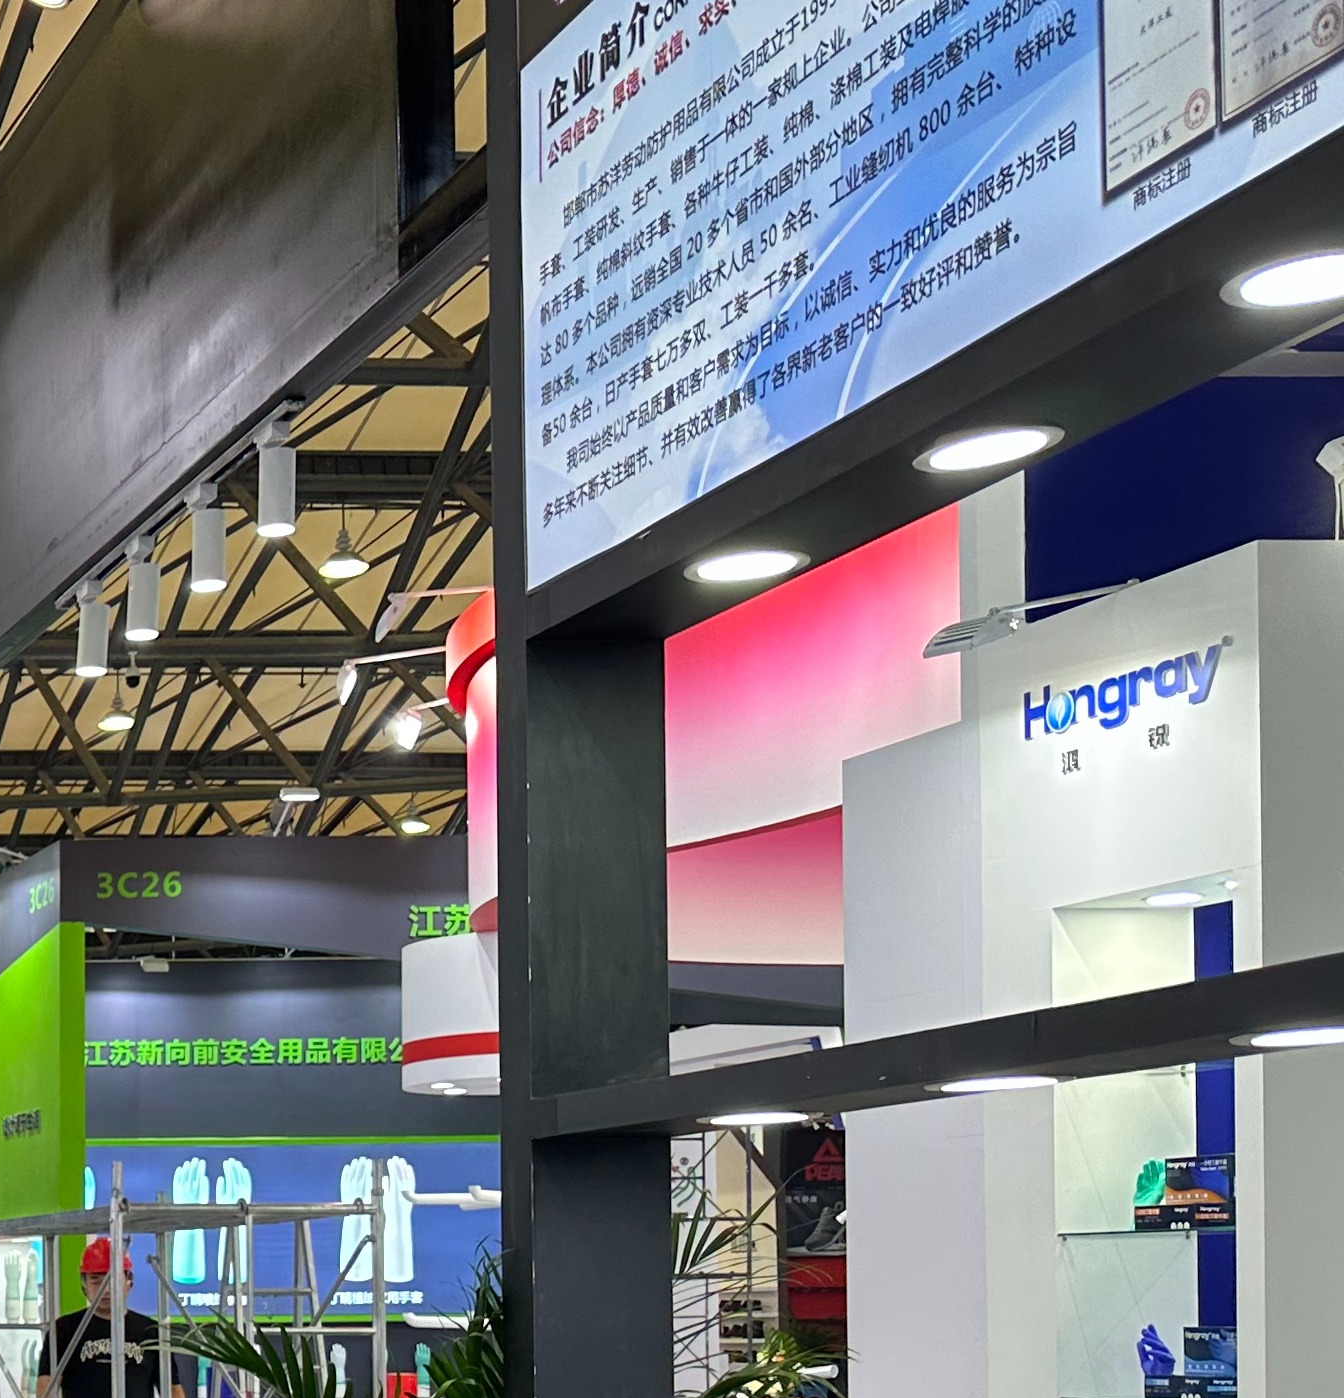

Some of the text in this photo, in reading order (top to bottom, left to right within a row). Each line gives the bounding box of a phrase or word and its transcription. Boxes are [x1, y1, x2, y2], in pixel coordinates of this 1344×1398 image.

[546, 2, 649, 129] 企业简介
[563, 0, 837, 228] 邯郸市苏洋劳动防护用品有限公司成立于199
[1252, 79, 1318, 138] 商标注册
[1133, 157, 1191, 211] 商标注册
[1023, 643, 1223, 741] Hongray
[29, 877, 55, 914] 3C26
[96, 871, 182, 899] 3C26
[409, 903, 471, 937] 江苏
[84, 1036, 403, 1067] 江苏新向前安全用品有限公
